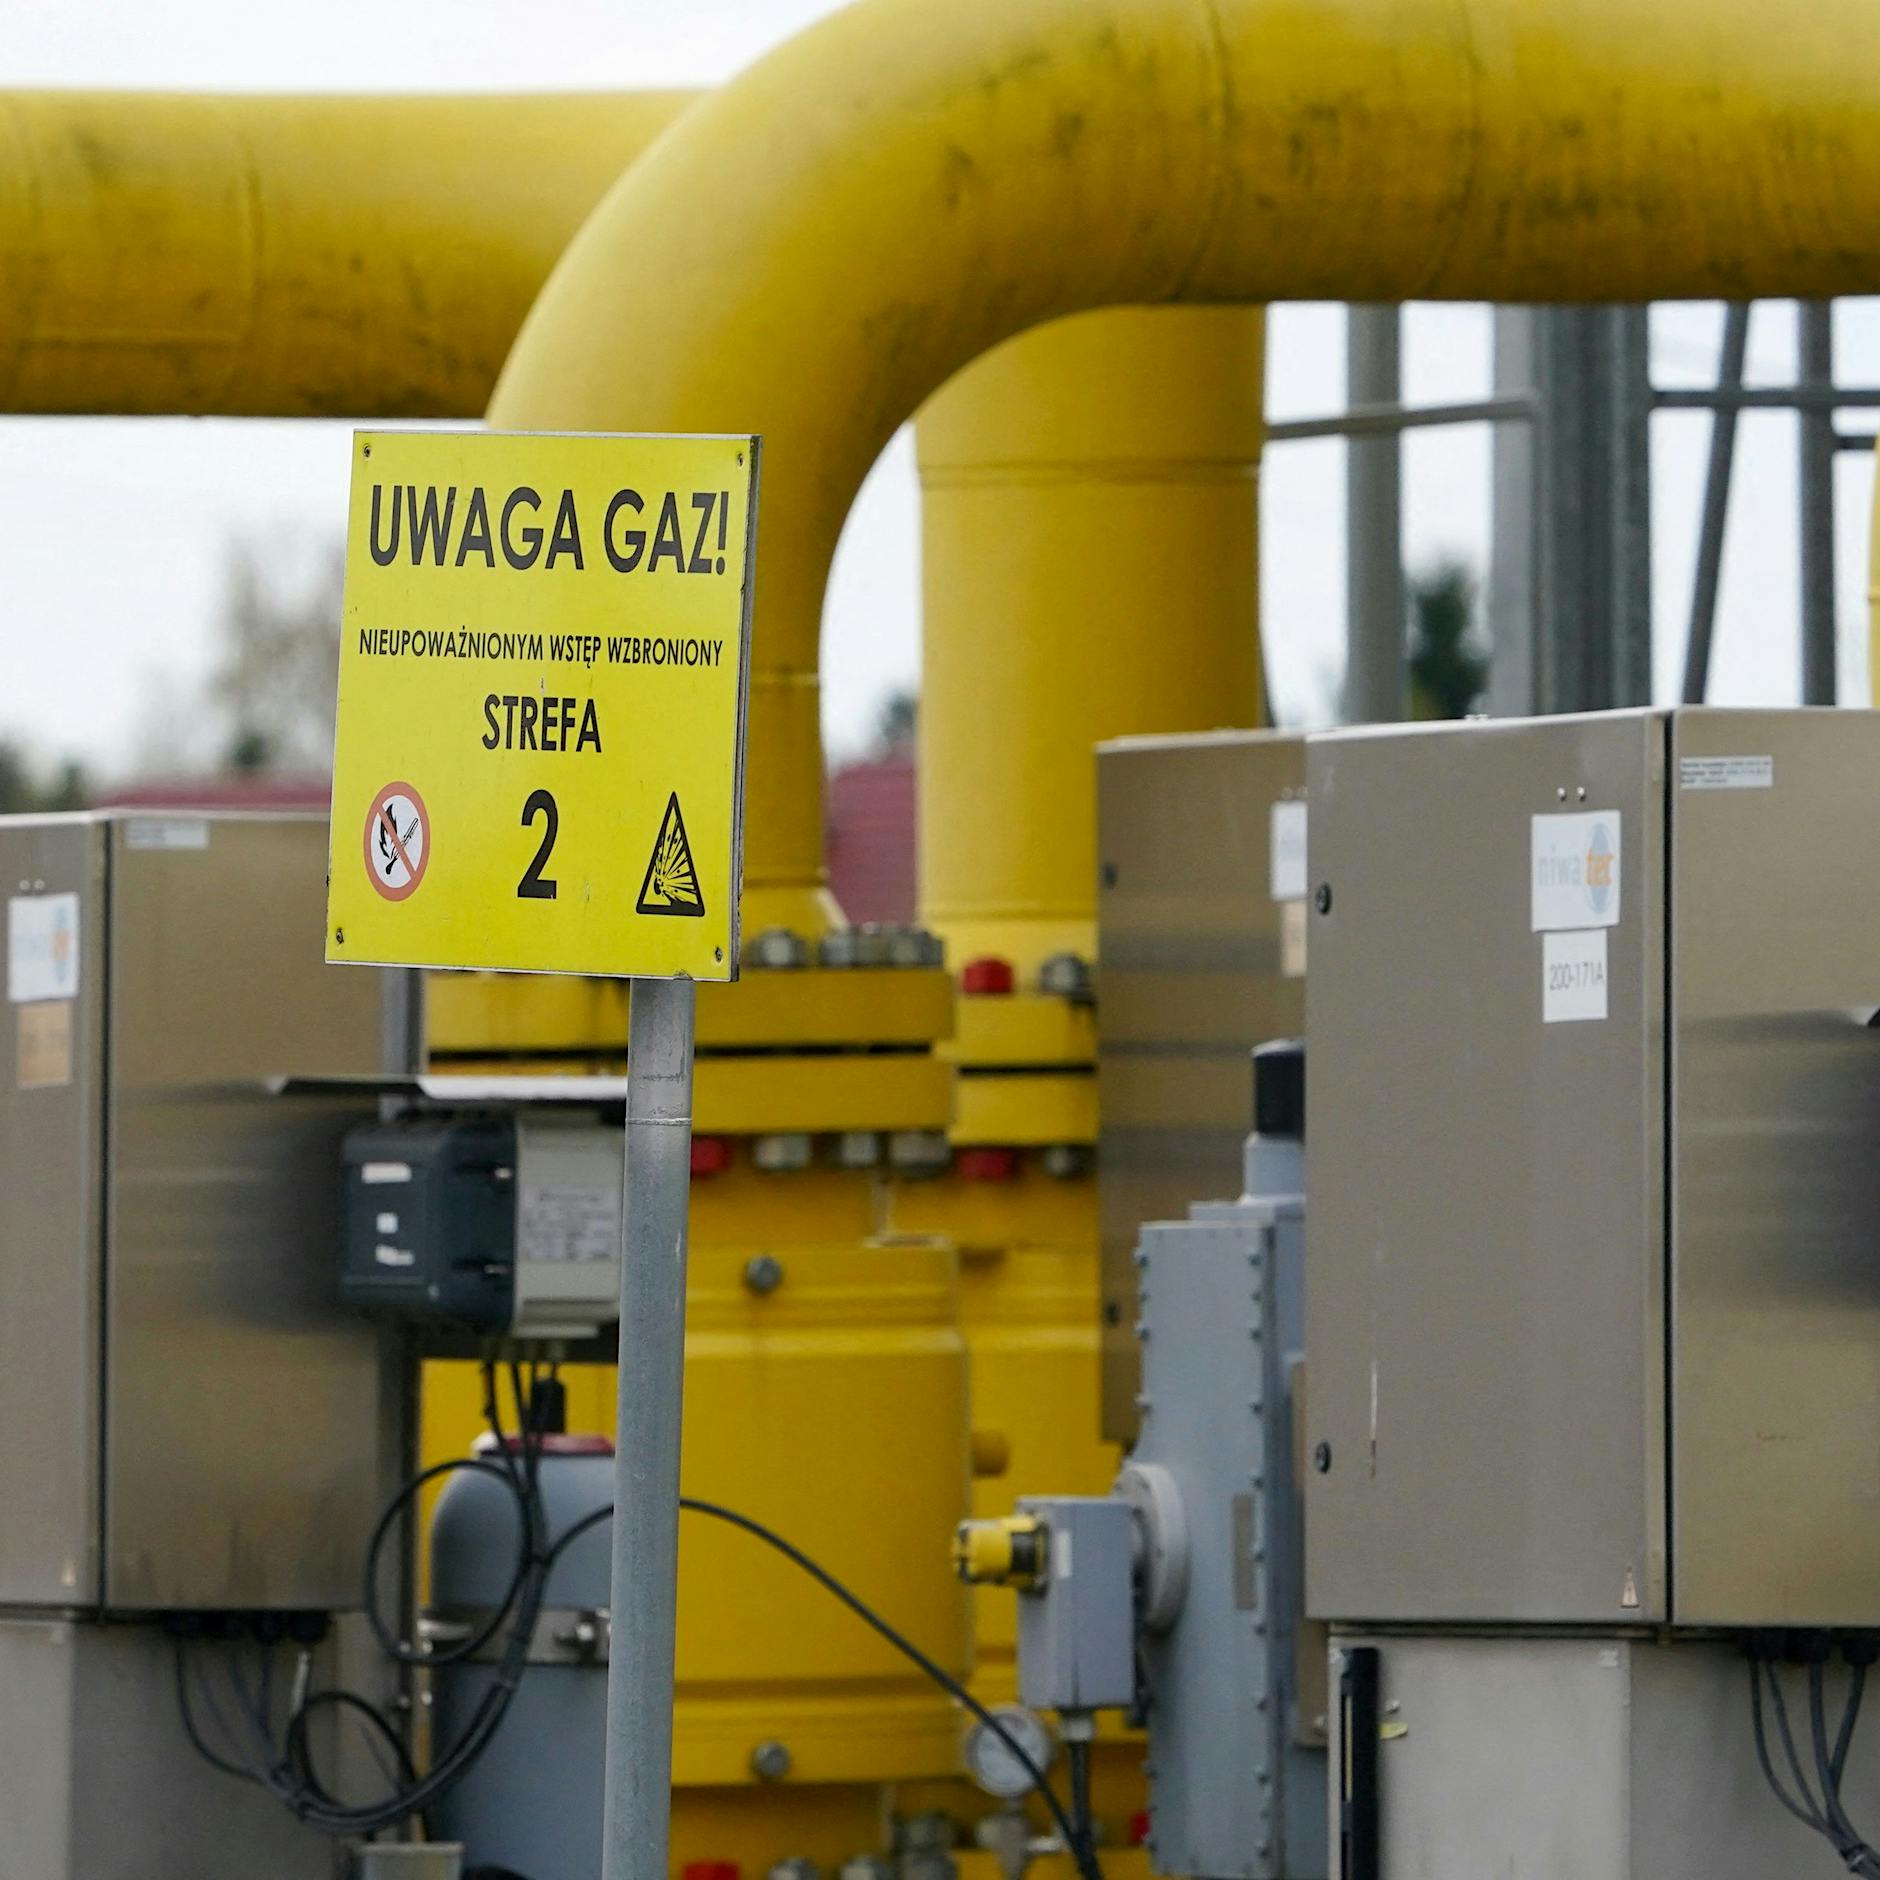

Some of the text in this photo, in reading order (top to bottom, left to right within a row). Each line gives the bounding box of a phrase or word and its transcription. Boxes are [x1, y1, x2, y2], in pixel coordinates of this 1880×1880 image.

[369, 484, 729, 576] UWAGA GAZ!
[359, 625, 724, 669] NIEUPOWAŻNIONYM WSTĘP WZBRONIONY
[481, 693, 602, 754] STREFA
[516, 788, 559, 900] 2
